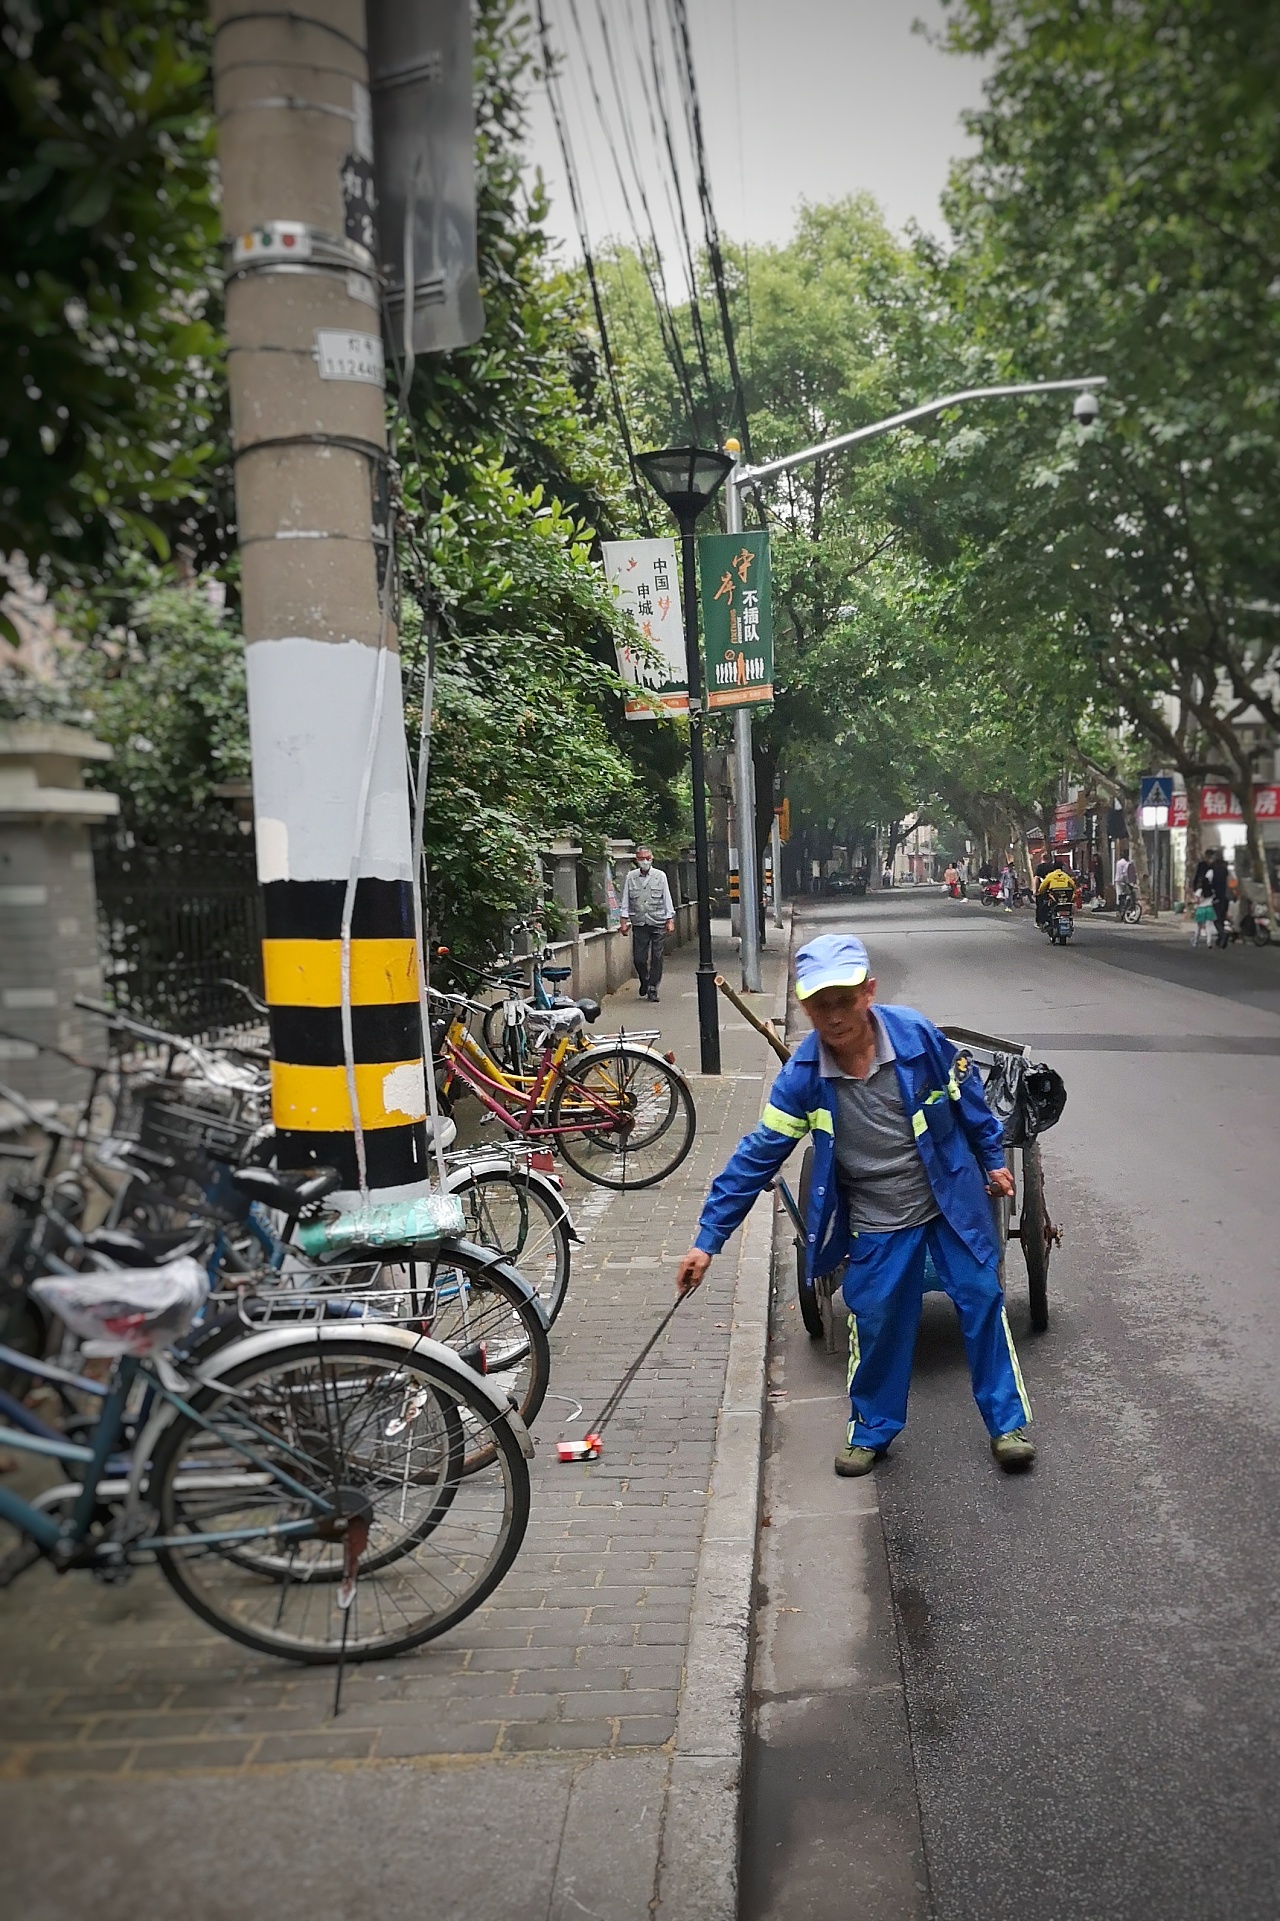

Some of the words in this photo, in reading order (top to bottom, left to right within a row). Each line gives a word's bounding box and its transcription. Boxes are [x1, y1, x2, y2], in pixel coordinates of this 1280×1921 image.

[653, 558, 673, 622] 中国梦
[742, 590, 760, 642] 不插队
